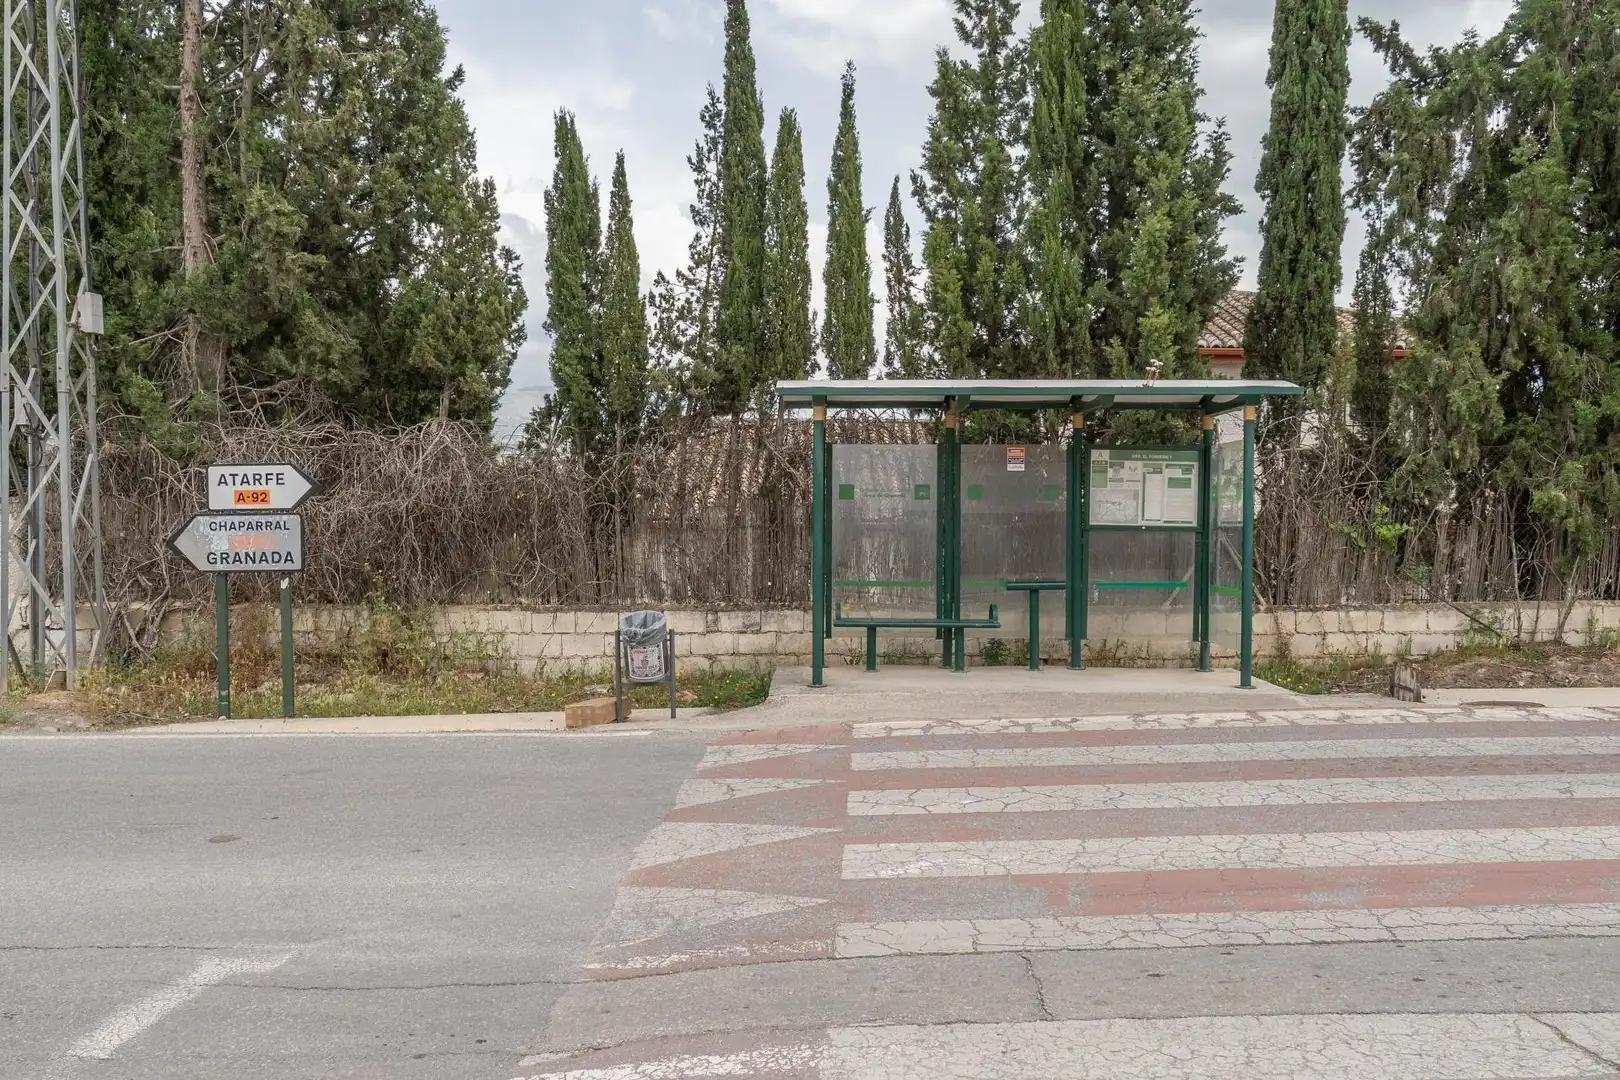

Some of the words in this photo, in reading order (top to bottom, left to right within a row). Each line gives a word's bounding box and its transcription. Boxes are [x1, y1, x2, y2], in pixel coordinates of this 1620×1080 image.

[217, 472, 286, 487] ATARFE
[236, 492, 268, 503] A-92
[209, 520, 290, 532] CHAPARRAL
[207, 551, 294, 565] GRANADA
